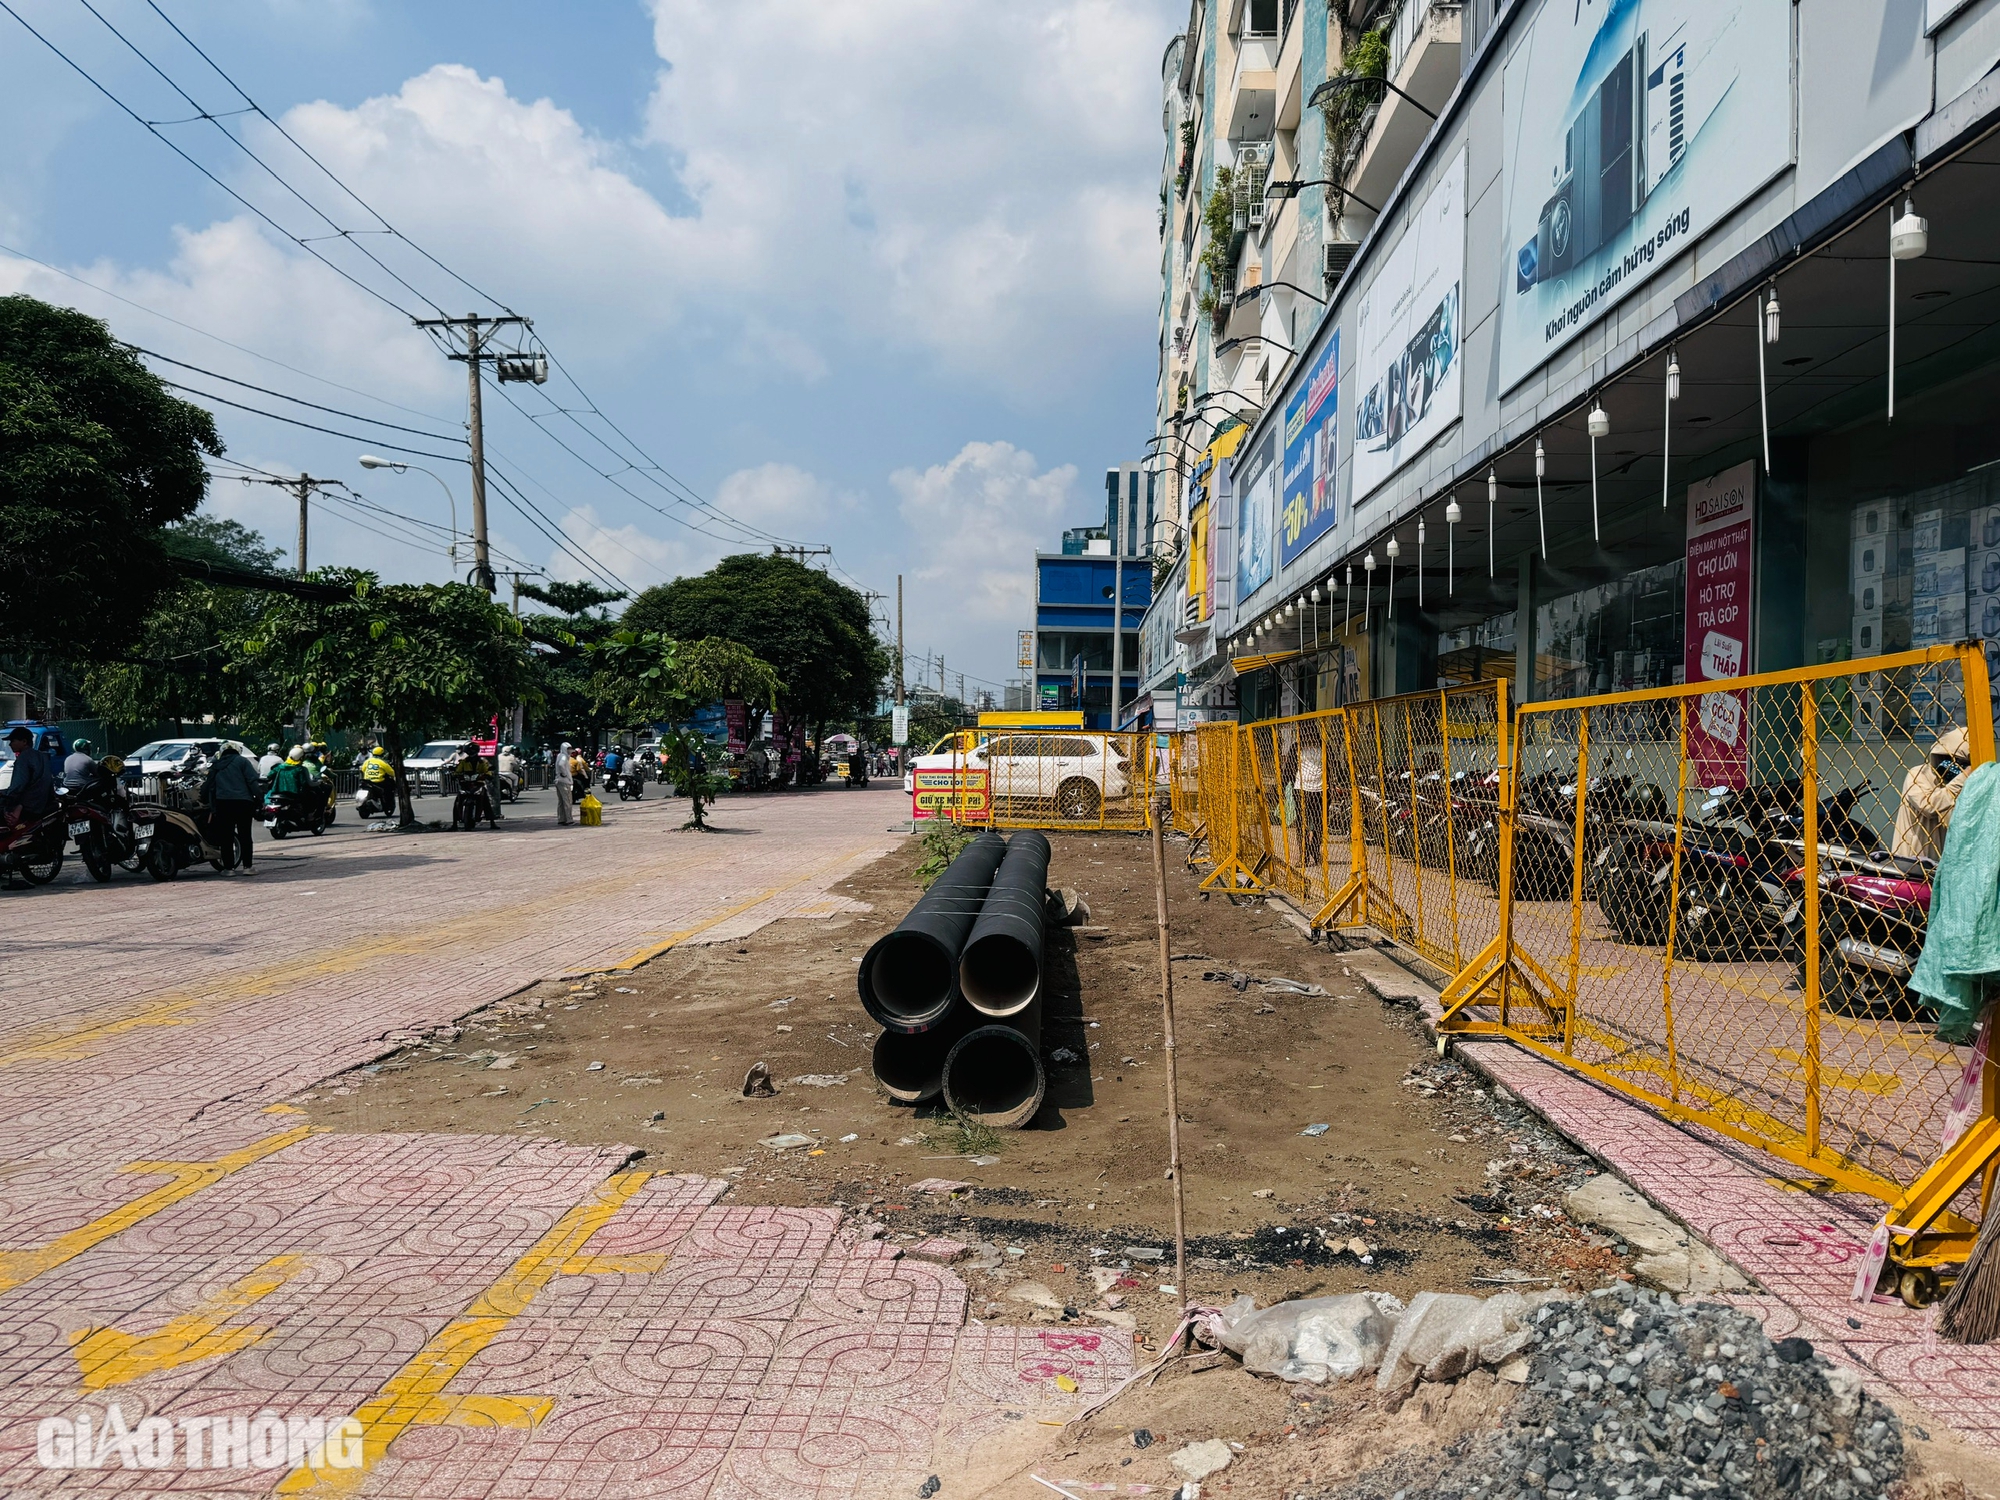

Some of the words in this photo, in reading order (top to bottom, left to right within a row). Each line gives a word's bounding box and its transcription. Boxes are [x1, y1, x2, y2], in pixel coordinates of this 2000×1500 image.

[1567, 286, 1598, 325] nguồn
[1599, 267, 1622, 297] cảm
[1623, 243, 1655, 278] hứng
[1657, 205, 1690, 249] sống
[1703, 539, 1717, 552] MÁY
[1732, 525, 1748, 544] THẤT
[1697, 556, 1718, 578] CHỢ
[1718, 550, 1738, 572] LỚN
[1699, 583, 1713, 604] HỖ
[1714, 581, 1736, 602] TRỢ
[1697, 606, 1716, 628] TRẢ
[1717, 603, 1739, 625] GÓP
[1712, 653, 1737, 677] THẤP
[1178, 683, 1193, 694] TẤT
[934, 796, 945, 804] XE
